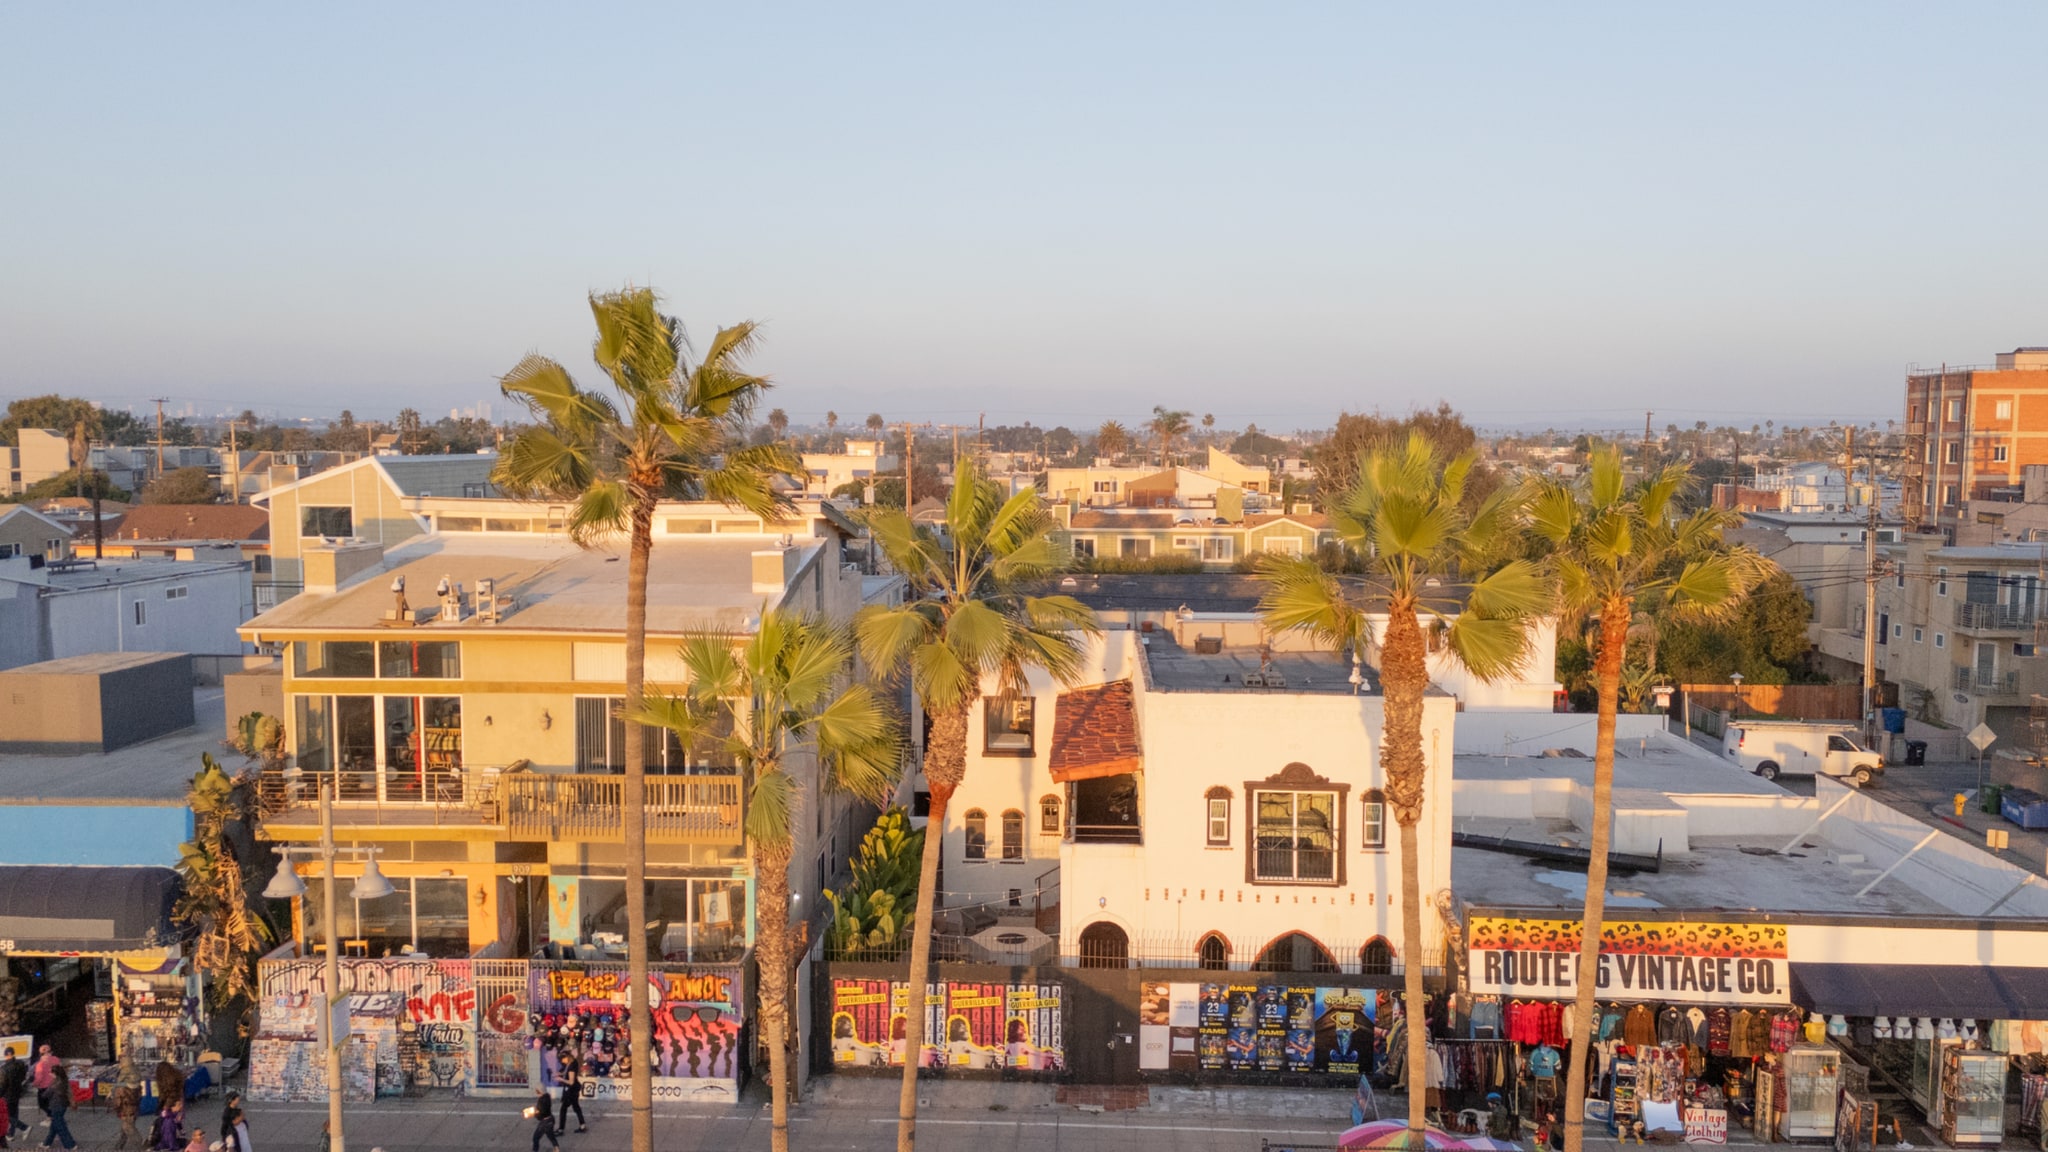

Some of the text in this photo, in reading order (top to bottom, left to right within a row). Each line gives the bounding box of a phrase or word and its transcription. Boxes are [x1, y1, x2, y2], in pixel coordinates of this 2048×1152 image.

[1485, 950, 1571, 986] ROUTE
[1618, 954, 1731, 992] VINTAGE
[1737, 958, 1782, 994] CO.
[1229, 985, 1257, 993] RAMS
[1044, 998, 1058, 1006] GIRL
[1207, 1002, 1220, 1013] 23
[1265, 1004, 1278, 1014] 23
[1685, 1109, 1726, 1128] Vintage
[1685, 1125, 1727, 1139] Clothing
